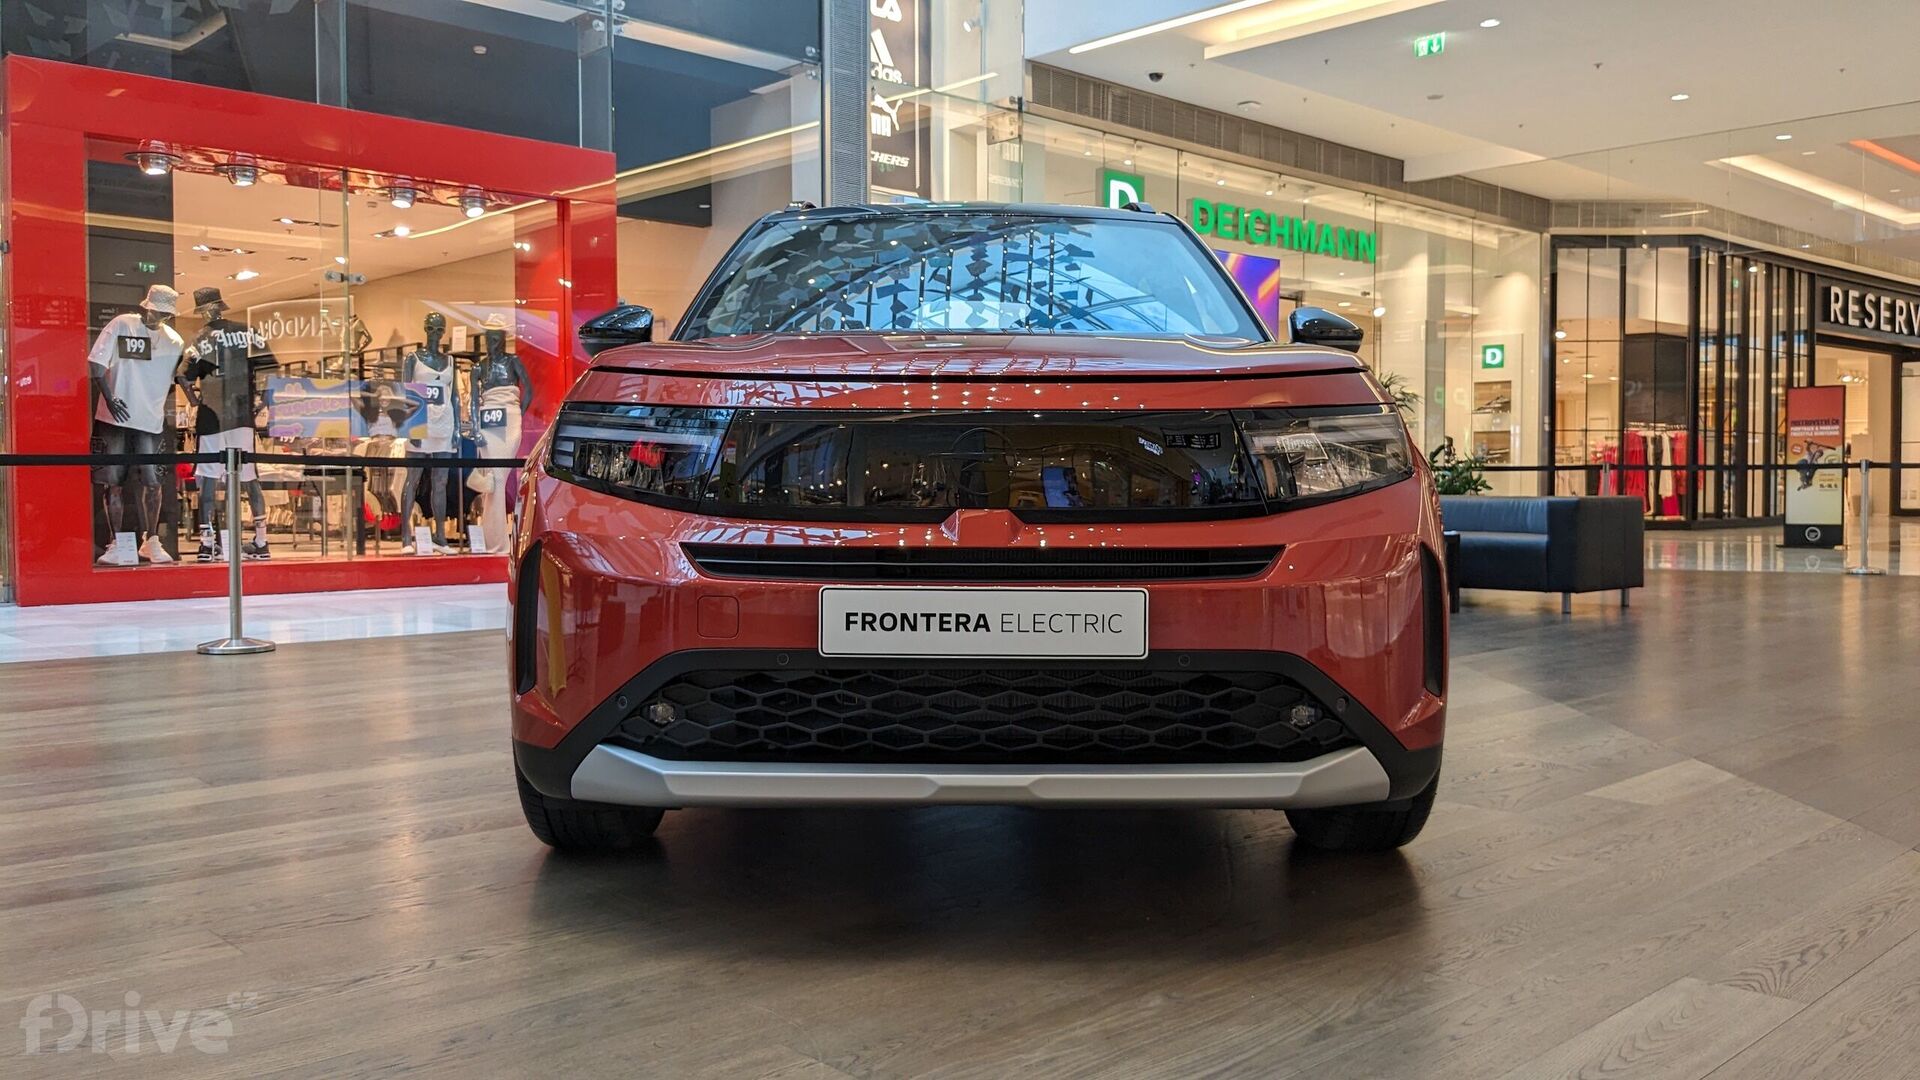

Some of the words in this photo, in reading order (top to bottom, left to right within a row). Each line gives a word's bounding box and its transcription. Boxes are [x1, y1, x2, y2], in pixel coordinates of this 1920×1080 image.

[870, 0, 902, 22] LA
[870, 64, 903, 84] das
[1192, 197, 1376, 264] DEICHMANN
[1830, 285, 1920, 337] RESERV
[125, 338, 146, 353] 199
[1485, 347, 1503, 365] D
[426, 387, 439, 399] 99
[483, 409, 503, 424] 649
[845, 612, 991, 633] FRONTERA
[1000, 613, 1123, 634] ELECTRIC
